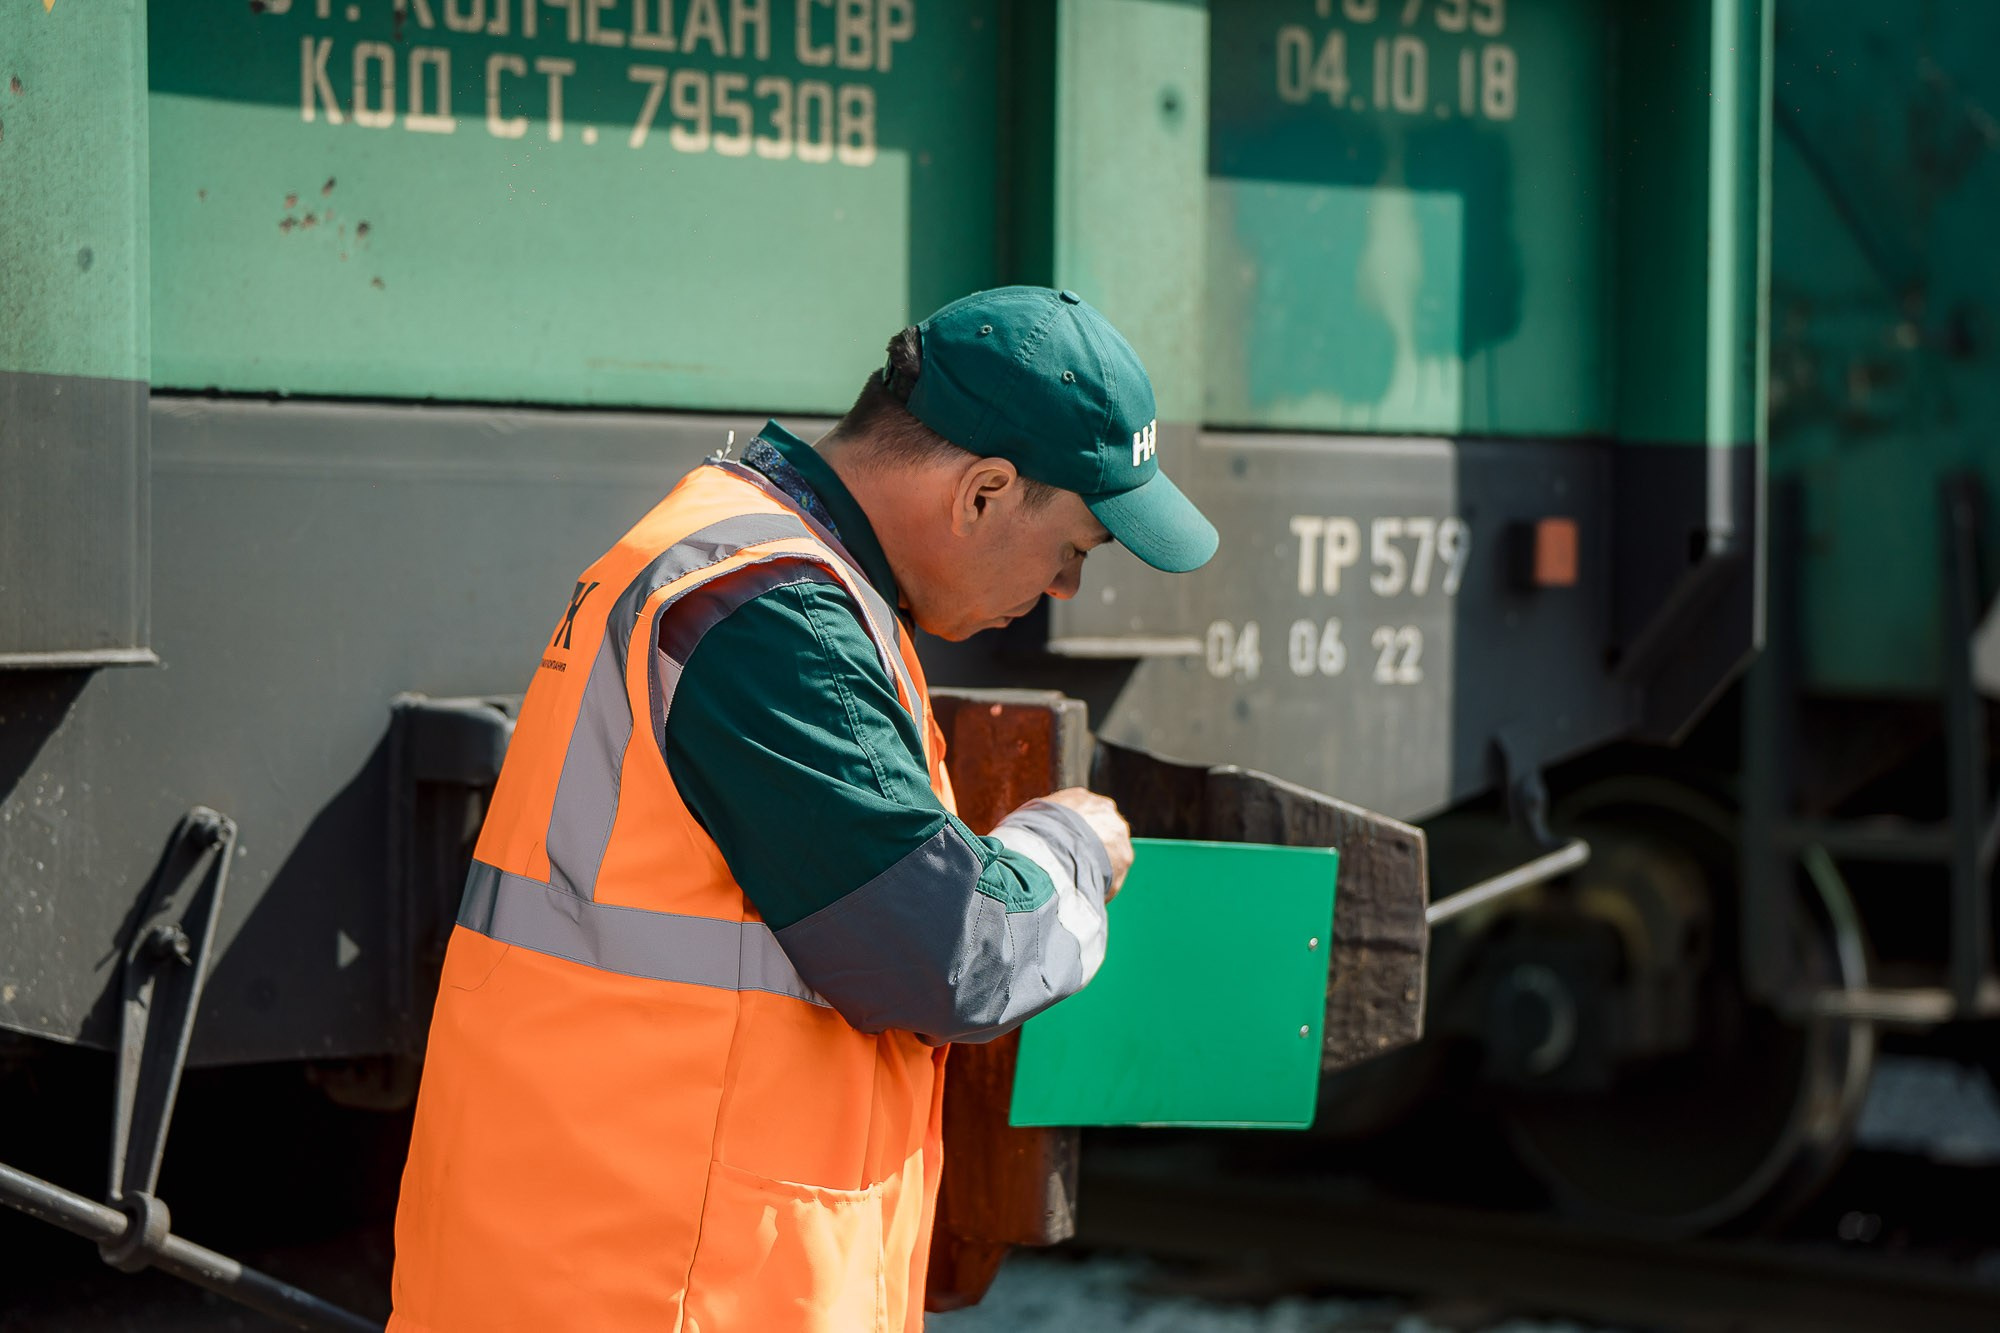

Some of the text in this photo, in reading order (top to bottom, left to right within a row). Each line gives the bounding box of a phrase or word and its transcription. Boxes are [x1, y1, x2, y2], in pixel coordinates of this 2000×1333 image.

[795, 0, 915, 72] СВР
[301, 36, 878, 167] КОД СТ. 795308
[1369, 515, 1471, 598] 579
[1206, 616, 1424, 685] 04 06 22
